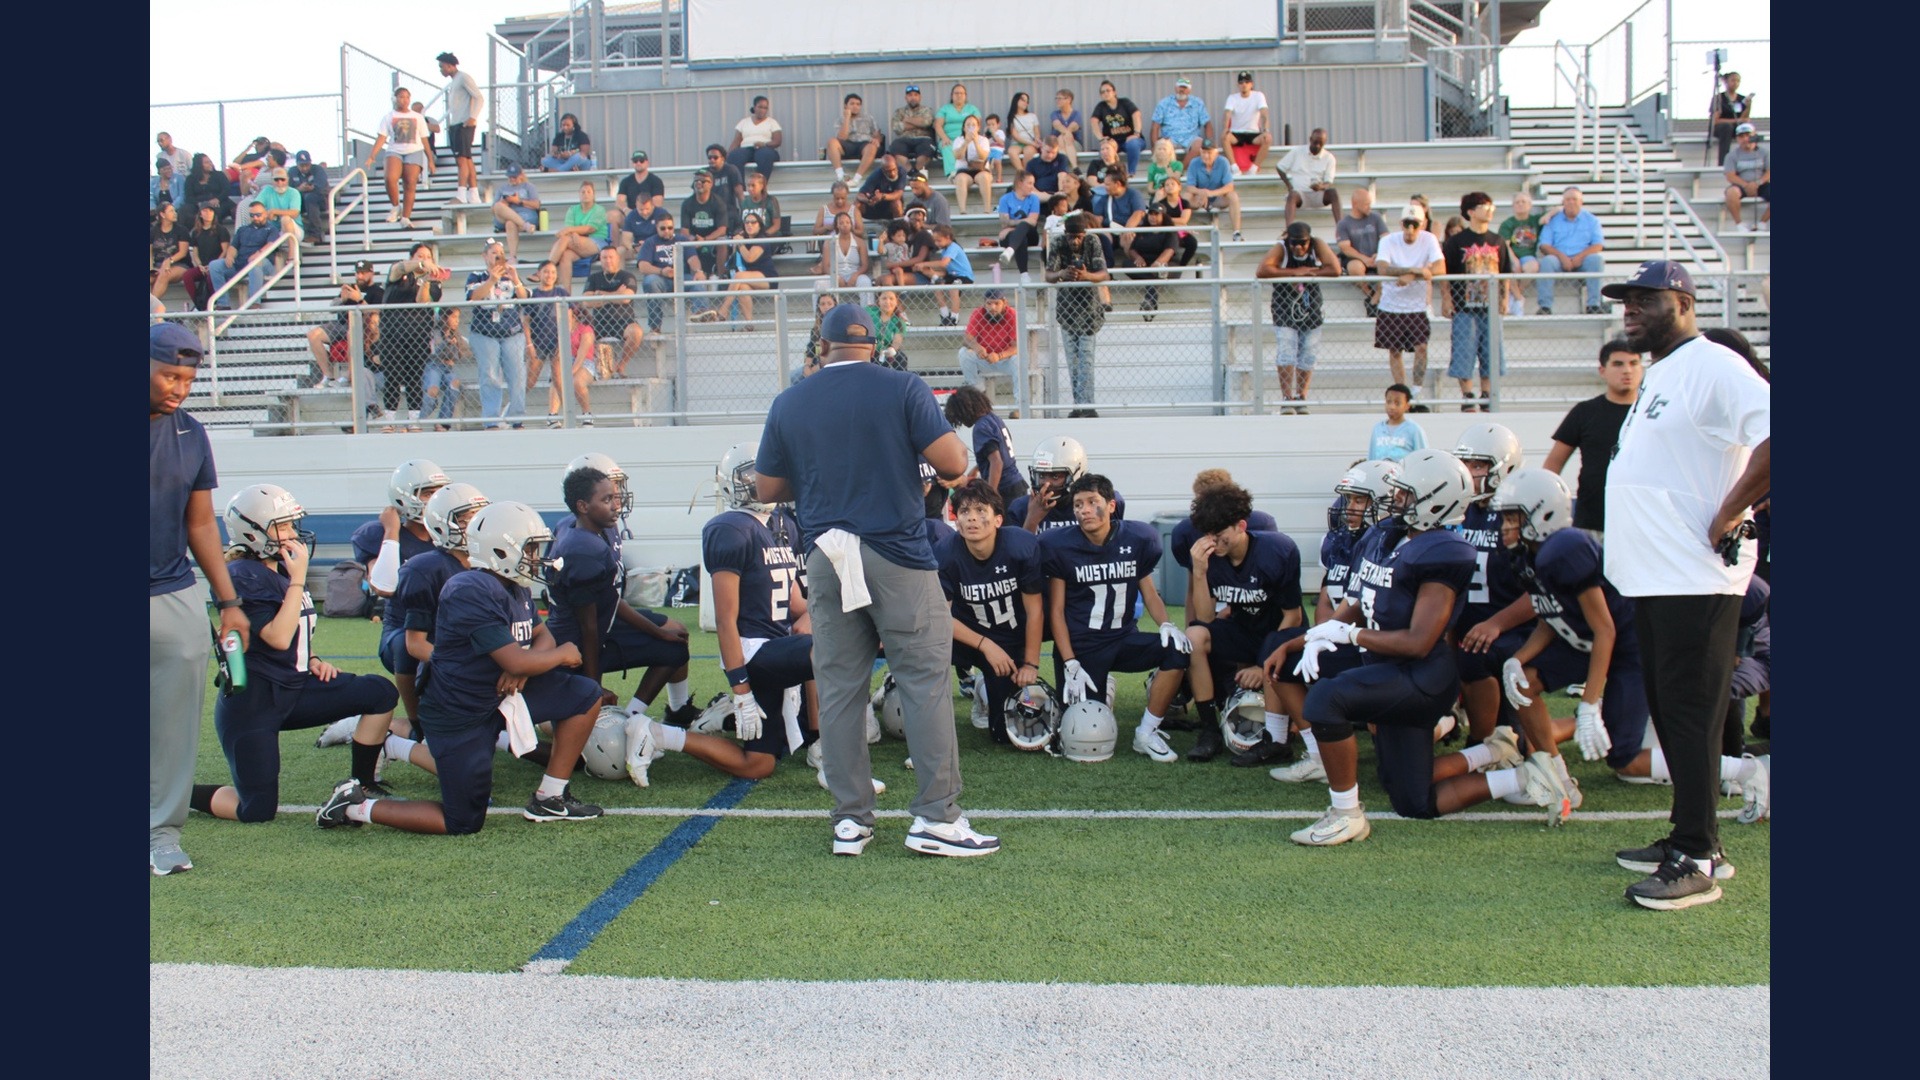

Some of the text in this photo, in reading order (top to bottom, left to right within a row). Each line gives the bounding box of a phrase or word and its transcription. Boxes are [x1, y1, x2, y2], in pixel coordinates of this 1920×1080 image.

[1074, 560, 1137, 583] MUSTANGS
[1088, 582, 1128, 630] 11
[1212, 585, 1268, 603] MUSTANGS
[966, 595, 1018, 630] 14
